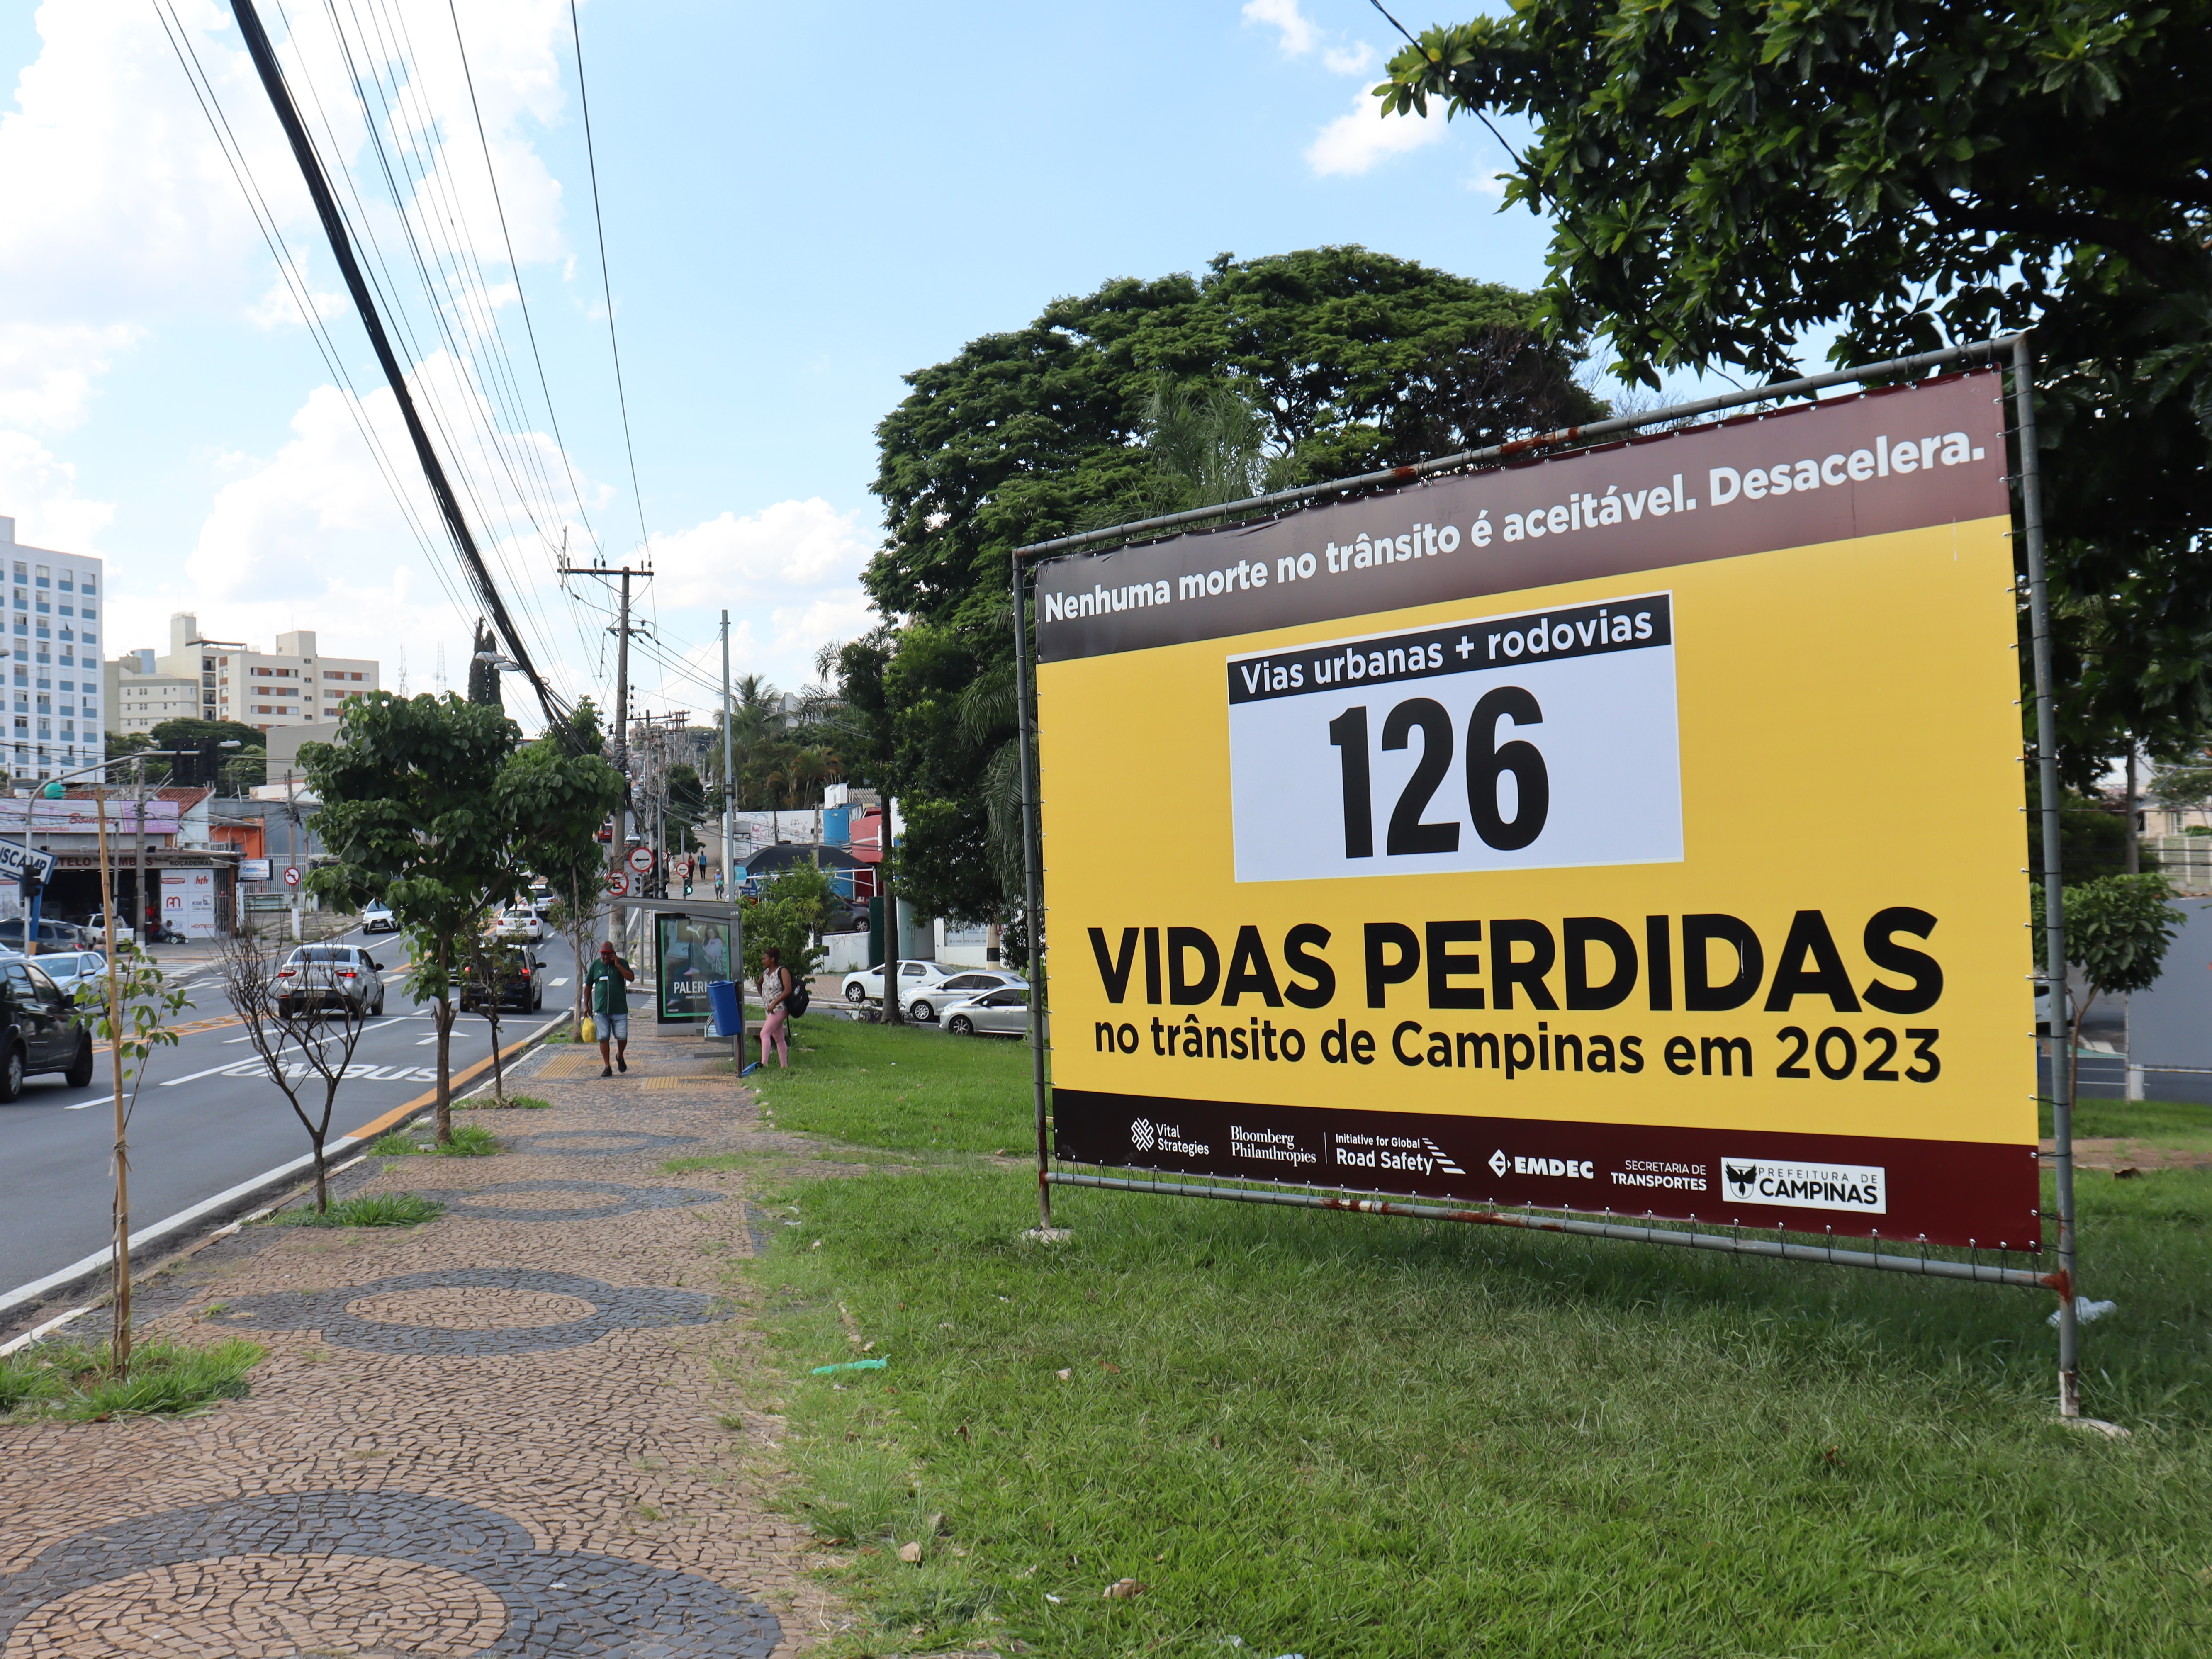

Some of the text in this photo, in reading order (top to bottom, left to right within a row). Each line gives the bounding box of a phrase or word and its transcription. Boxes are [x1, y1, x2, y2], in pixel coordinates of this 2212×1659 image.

[1046, 433, 1984, 622] Nenhuma morte no trânsito é aceitável. Desacelera.
[1241, 609, 1653, 694] Vias urbanas + rodovias
[1329, 685, 1549, 859] 126
[196, 876, 208, 885] hth
[1087, 907, 1943, 1014] VIDAS PERDIDAS
[1095, 1014, 1940, 1083] no trânsito de Campinas em 2023
[1156, 1124, 1180, 1138] Vital
[1231, 1126, 1294, 1150] Bloomberg
[1336, 1134, 1420, 1148] Initiative for Global
[1158, 1138, 1209, 1157] Strategies
[1231, 1141, 1316, 1167] Philanthropies
[1337, 1148, 1433, 1175] Road Safety
[1515, 1157, 1593, 1179] EMDEC
[1626, 1160, 1706, 1175] SECRETARIA DE
[1611, 1172, 1706, 1190] TRANSPORTES
[1759, 1168, 1877, 1183] PREFEITURA DE
[1760, 1178, 1877, 1204] CAMPINAS
